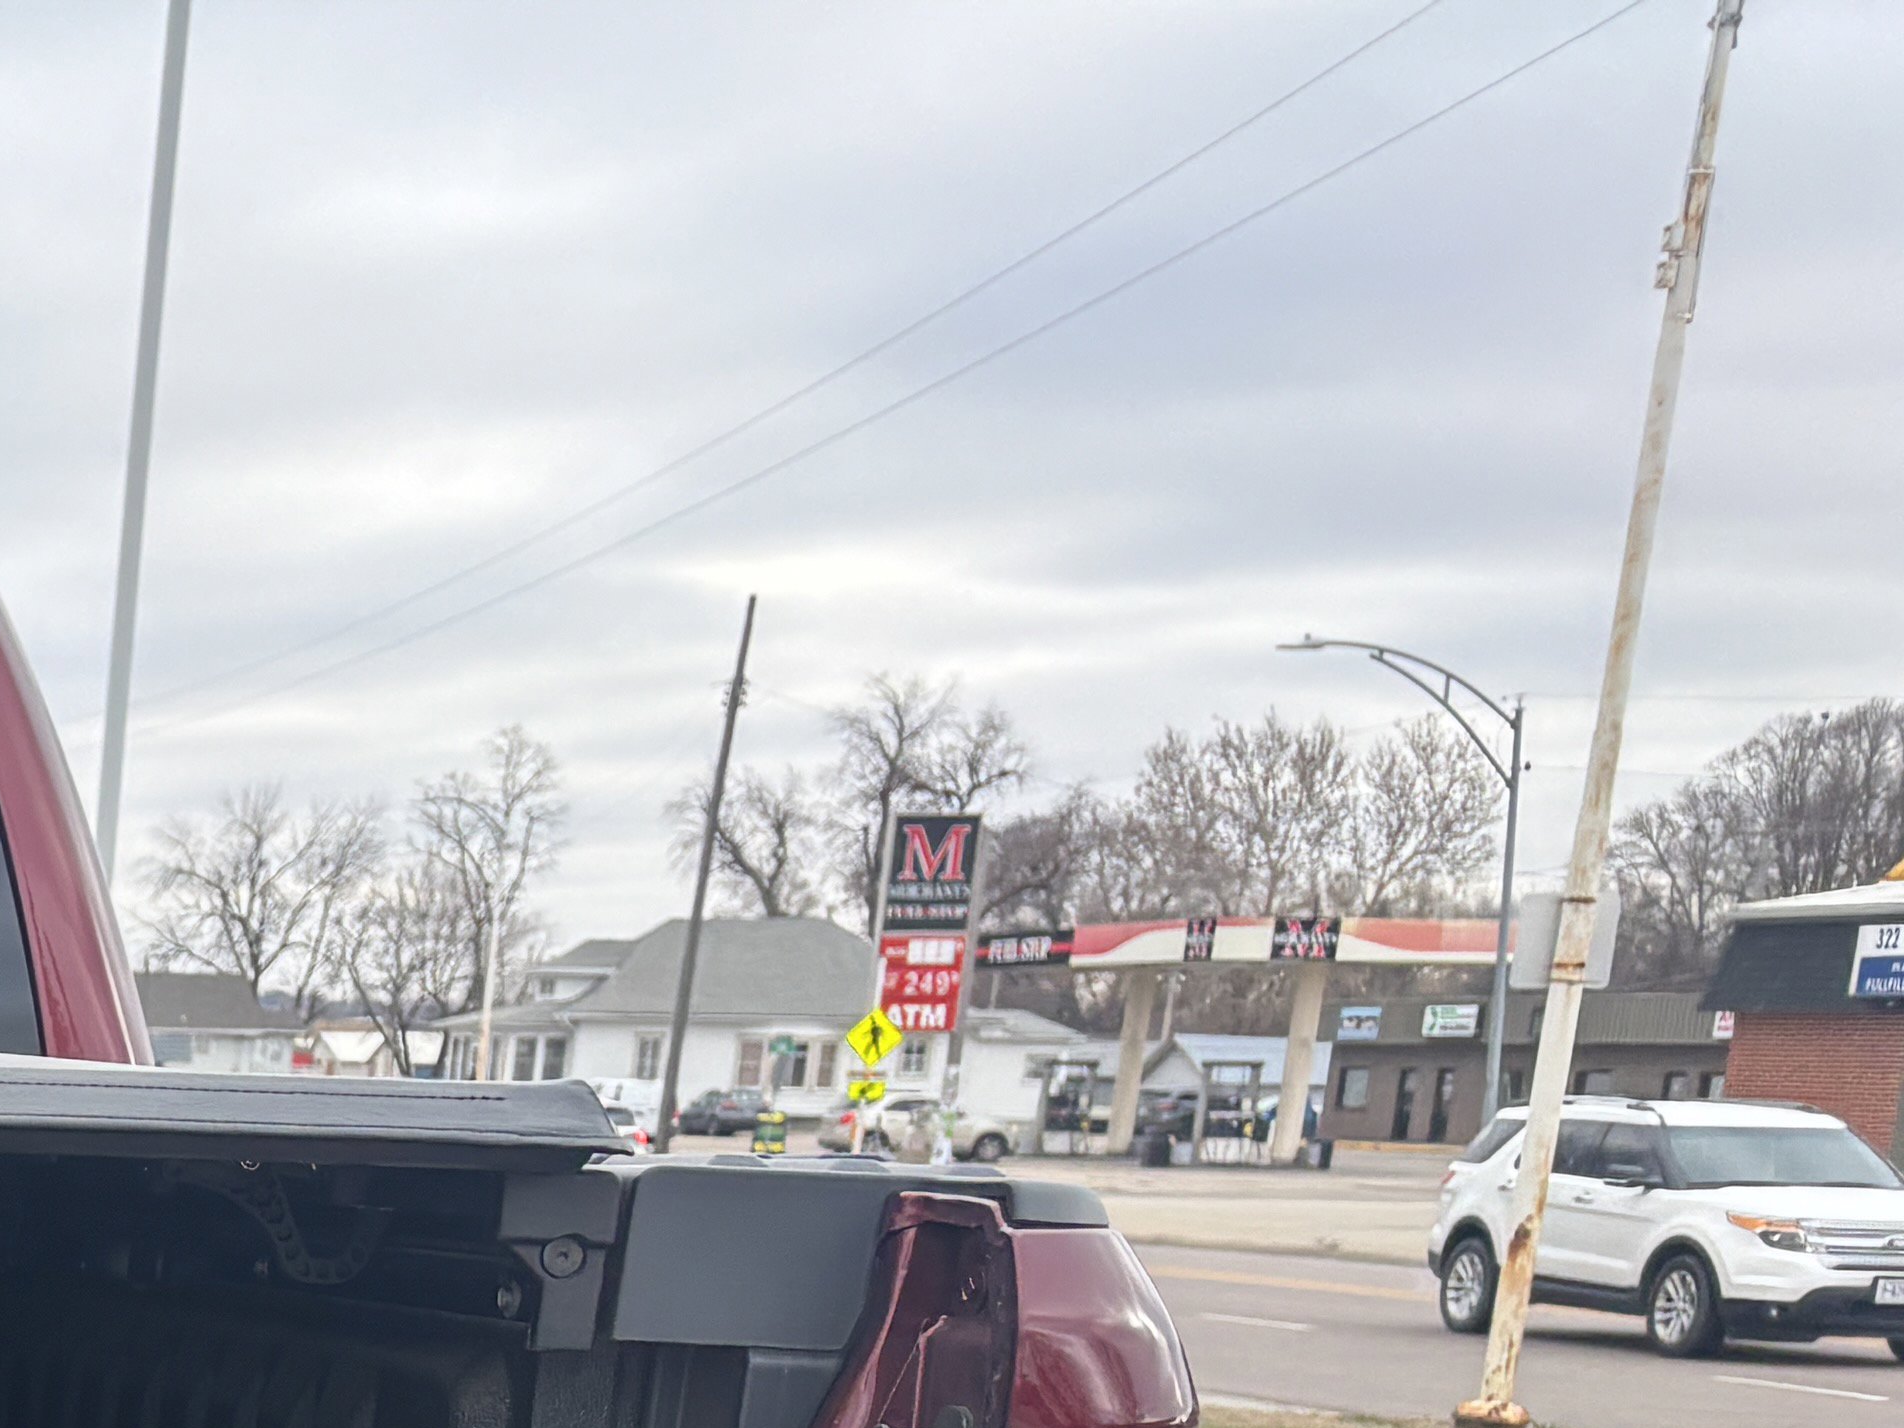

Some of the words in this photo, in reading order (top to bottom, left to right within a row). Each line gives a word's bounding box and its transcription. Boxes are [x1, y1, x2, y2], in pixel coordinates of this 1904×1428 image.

[897, 824, 972, 881] M
[1876, 927, 1901, 950] 322
[887, 1003, 947, 1029] ATM
